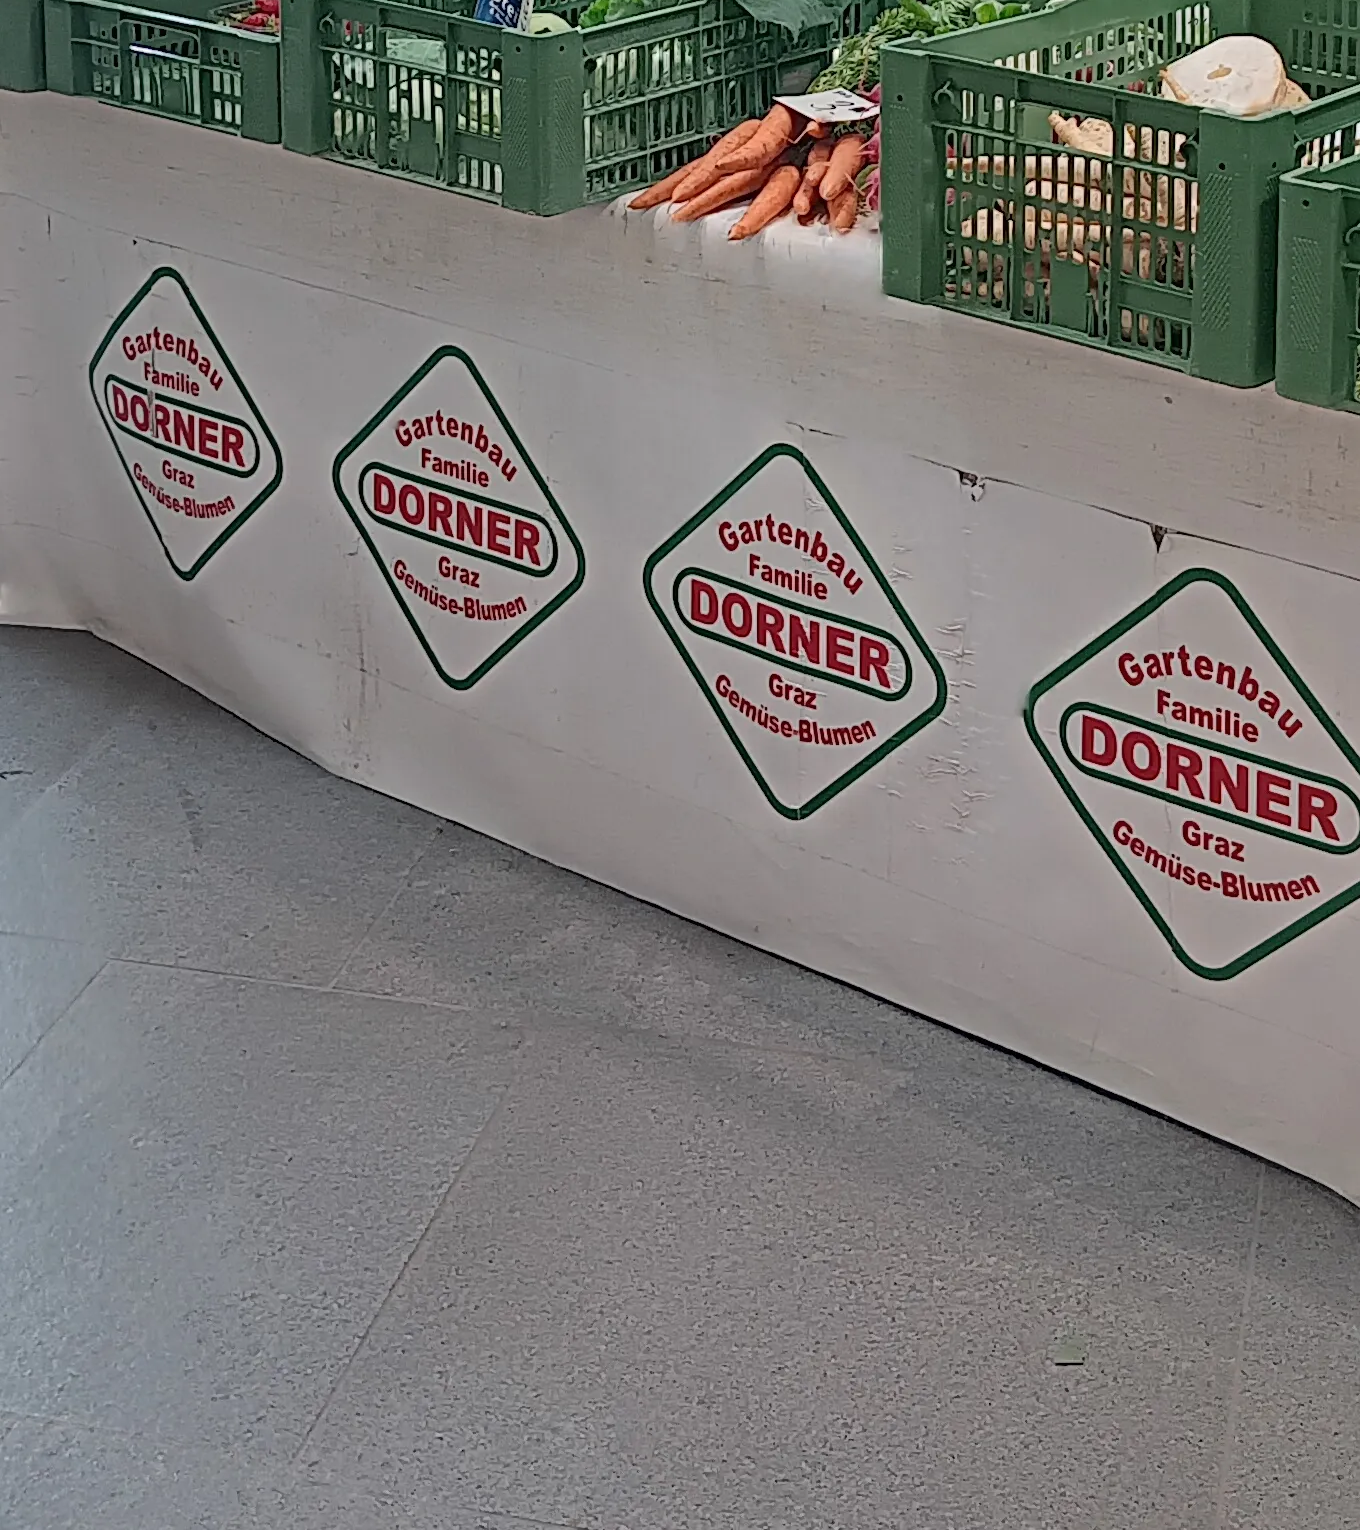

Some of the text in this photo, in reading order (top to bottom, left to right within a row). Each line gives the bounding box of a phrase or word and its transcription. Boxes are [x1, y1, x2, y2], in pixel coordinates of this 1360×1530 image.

[122, 327, 223, 390] Gartenbau
[144, 362, 200, 396] Familie
[112, 384, 245, 467] DORNER
[395, 409, 517, 481] Gartenbau
[133, 462, 235, 519] Gemüse-Blumen
[162, 460, 195, 489] Graz
[421, 448, 489, 487] Familie
[373, 473, 541, 566] DORNER
[438, 556, 480, 588] Graz
[718, 514, 863, 595] Gartenbau
[749, 553, 828, 600] Familie
[393, 560, 527, 622] Gemüse-Blumen
[690, 578, 892, 689] DORNER
[715, 674, 876, 746] Gemüse-Blumen
[768, 673, 818, 710] Graz
[1118, 645, 1303, 738] Gartenbau
[1156, 689, 1259, 743] Familie
[1081, 714, 1340, 842] DORNER
[1113, 820, 1321, 902] Gemüse-Blumen
[1182, 820, 1245, 862] Graz
